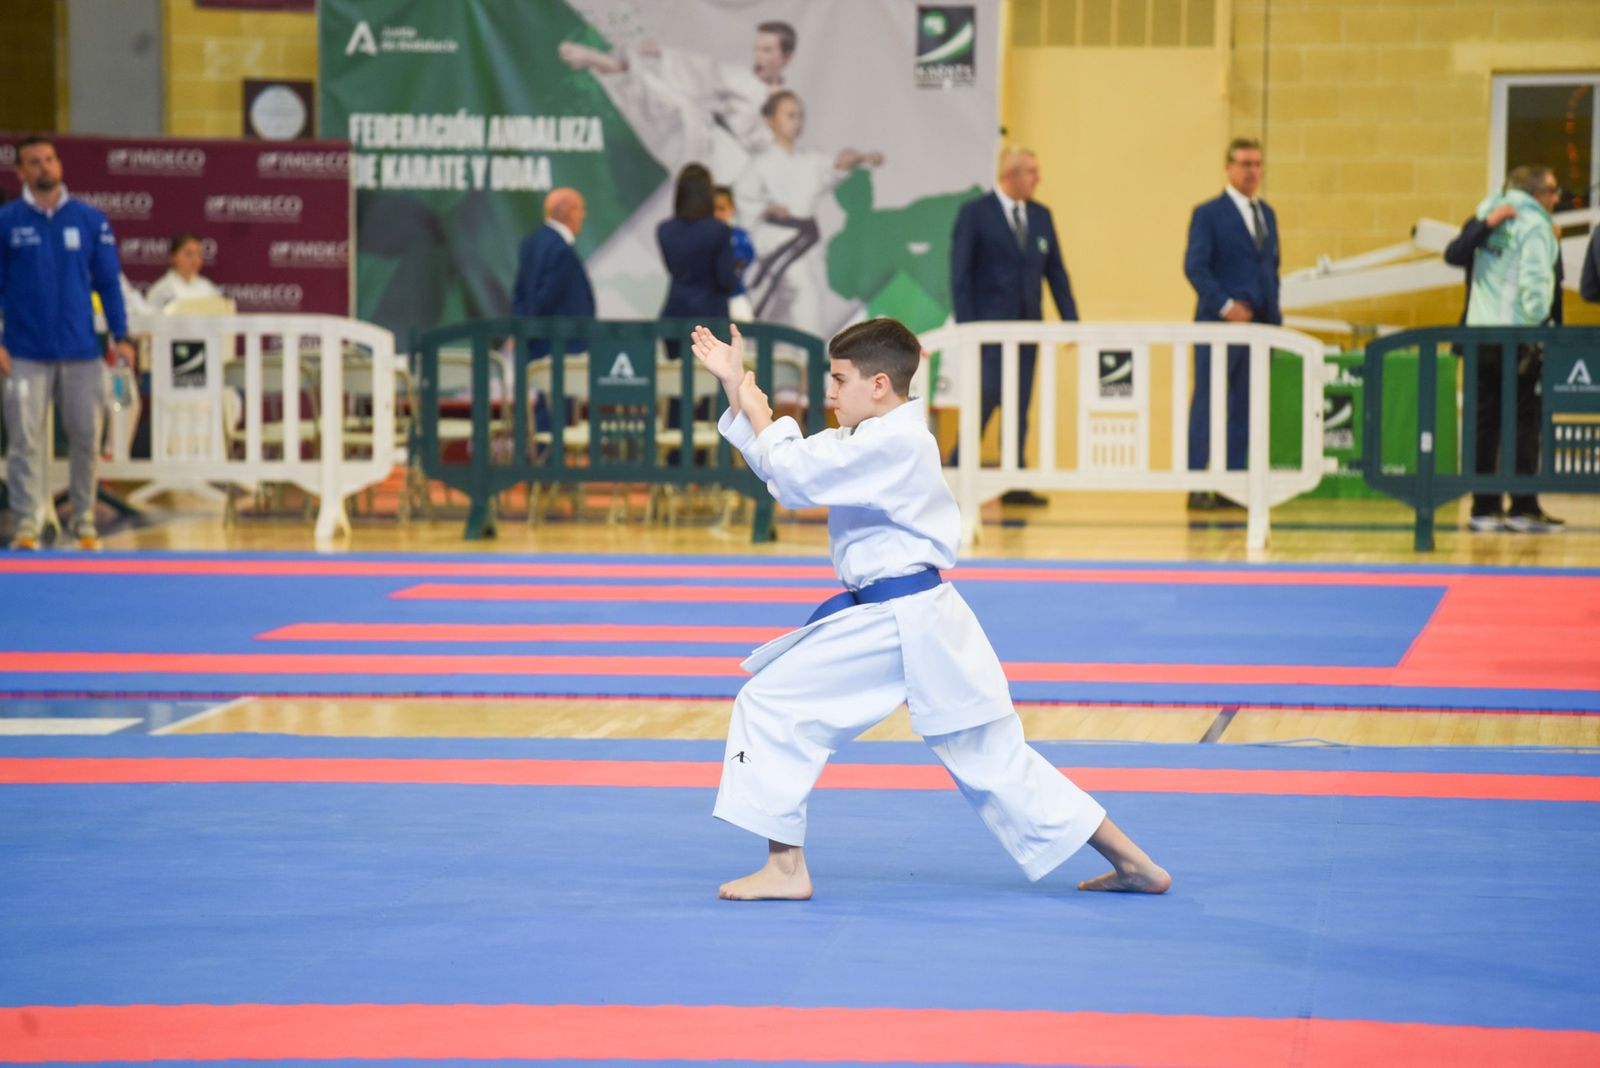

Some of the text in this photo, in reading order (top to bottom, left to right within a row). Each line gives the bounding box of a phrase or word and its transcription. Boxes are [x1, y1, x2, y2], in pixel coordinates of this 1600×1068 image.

[349, 108, 604, 151] FEDERACIÓN ANDALUZA
[381, 155, 466, 190] KARATE
[471, 156, 487, 190] Y
